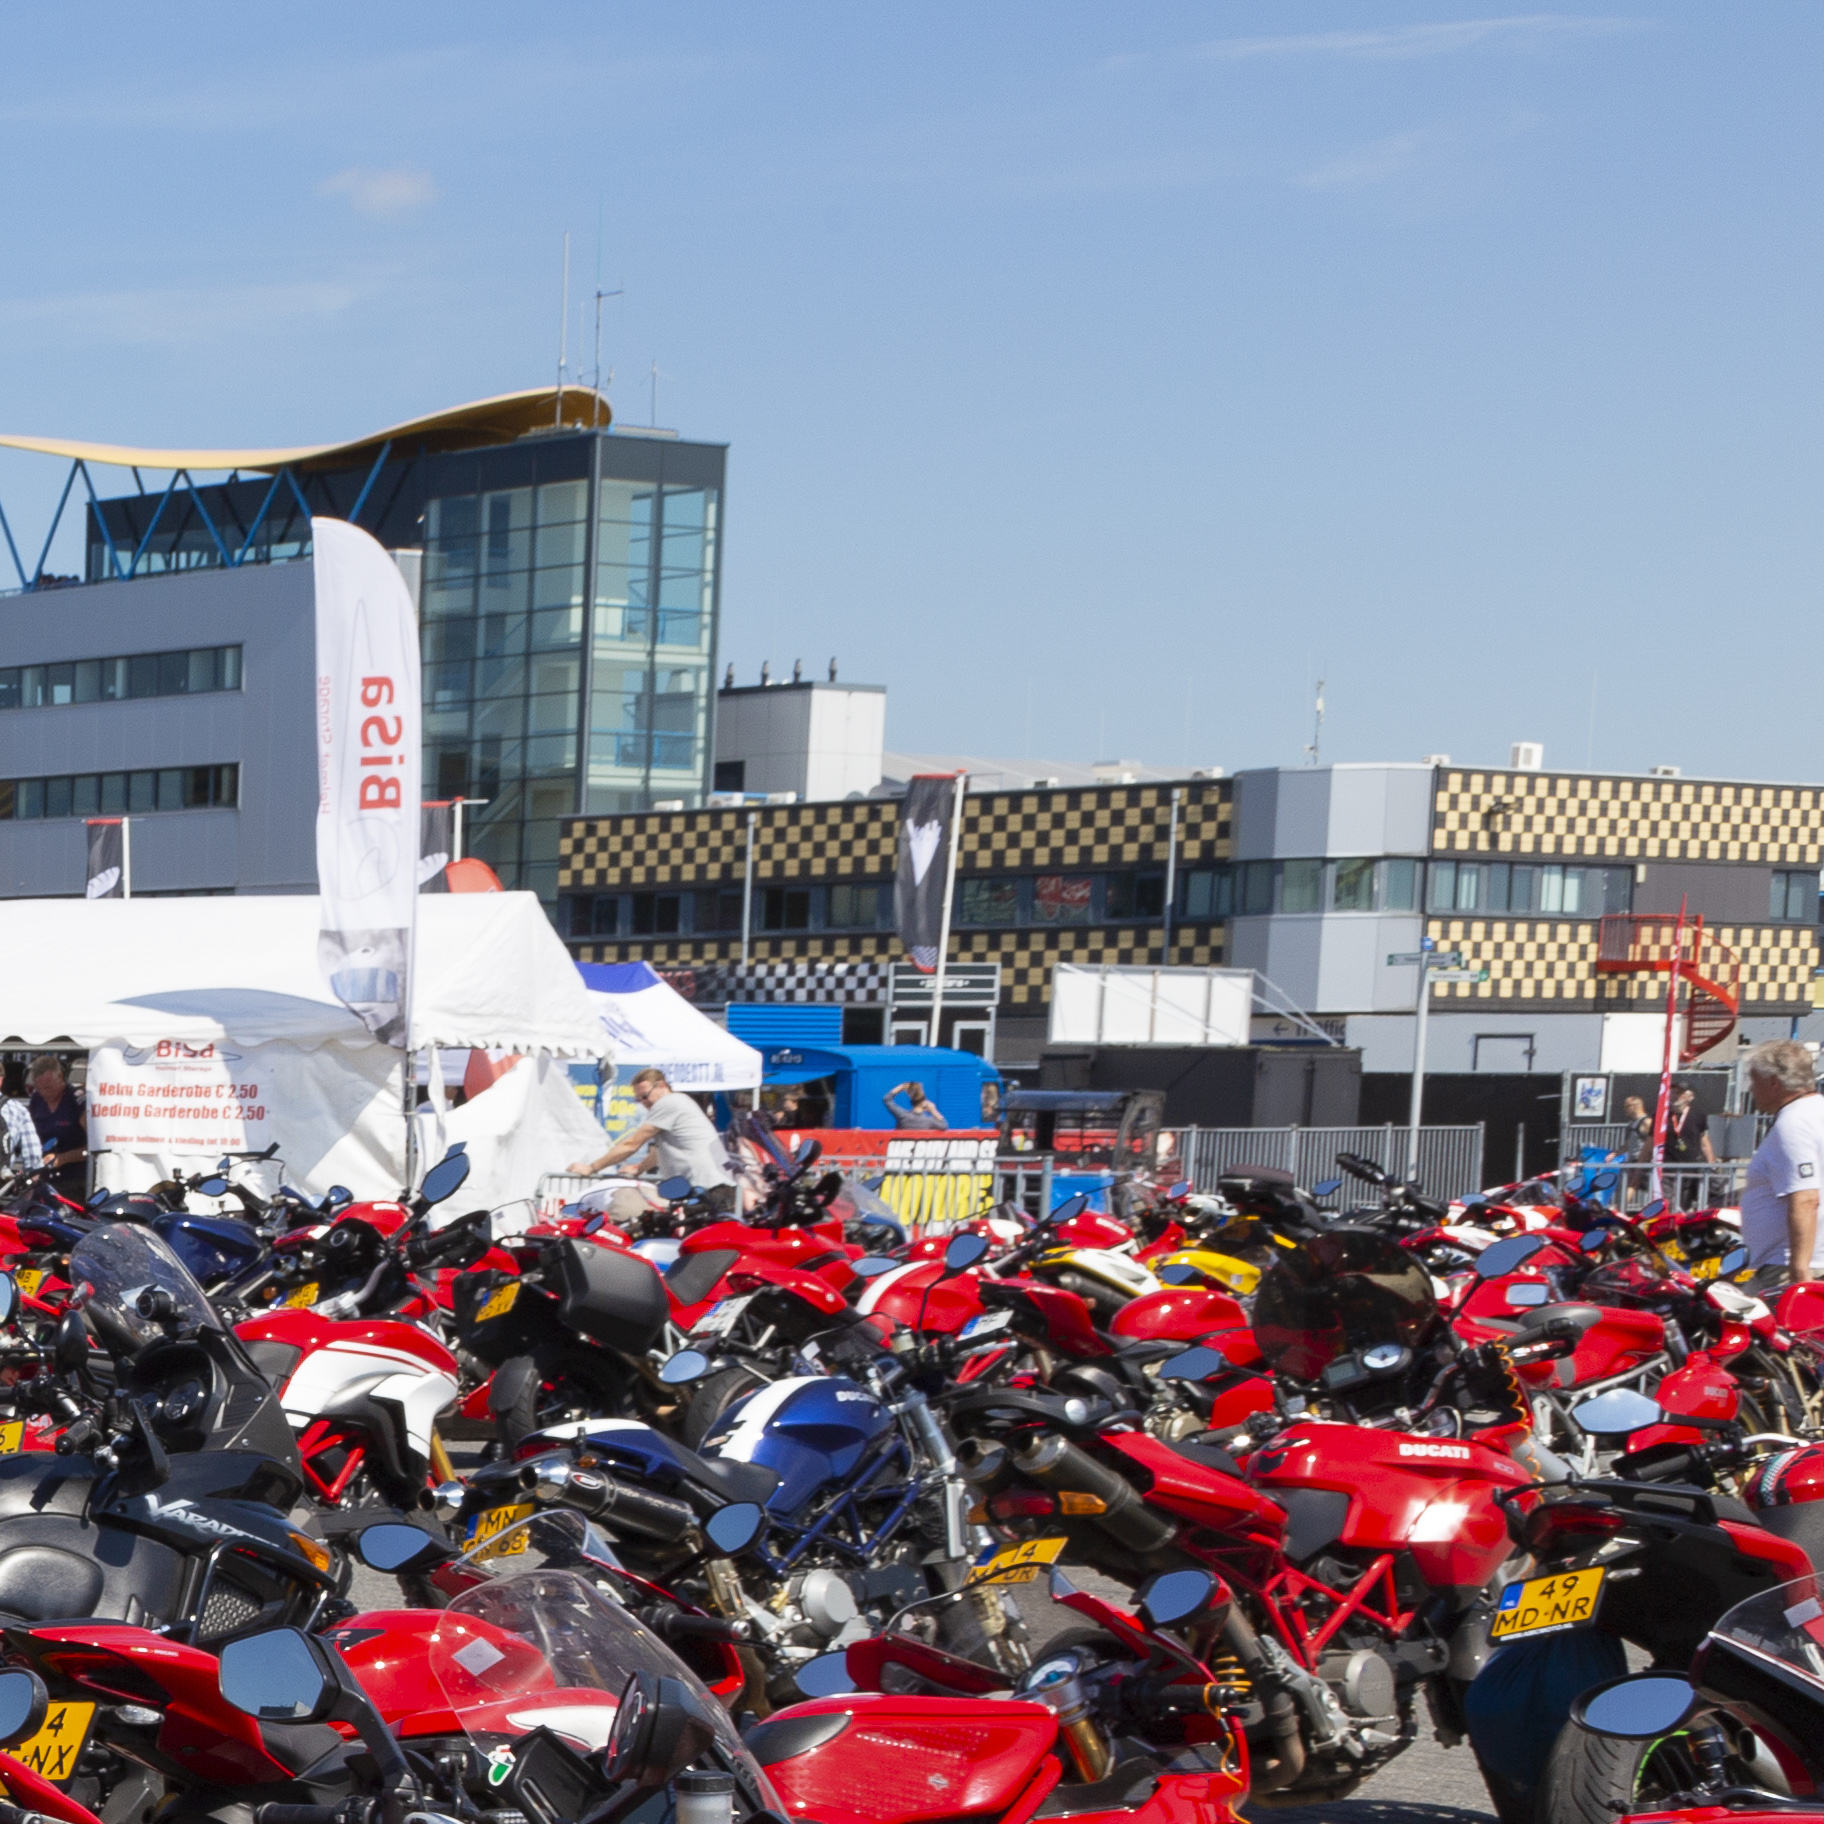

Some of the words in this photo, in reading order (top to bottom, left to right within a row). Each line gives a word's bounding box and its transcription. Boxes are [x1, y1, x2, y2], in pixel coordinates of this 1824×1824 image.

[98, 1084, 134, 1097] Helm
[137, 1084, 212, 1098] Garderobe
[91, 1103, 140, 1120] Kleding
[143, 1104, 219, 1120] Garderobe
[1399, 1443, 1470, 1460] DUCATI
[1538, 1574, 1579, 1601] 49
[1494, 1596, 1591, 1636] MD-NR
